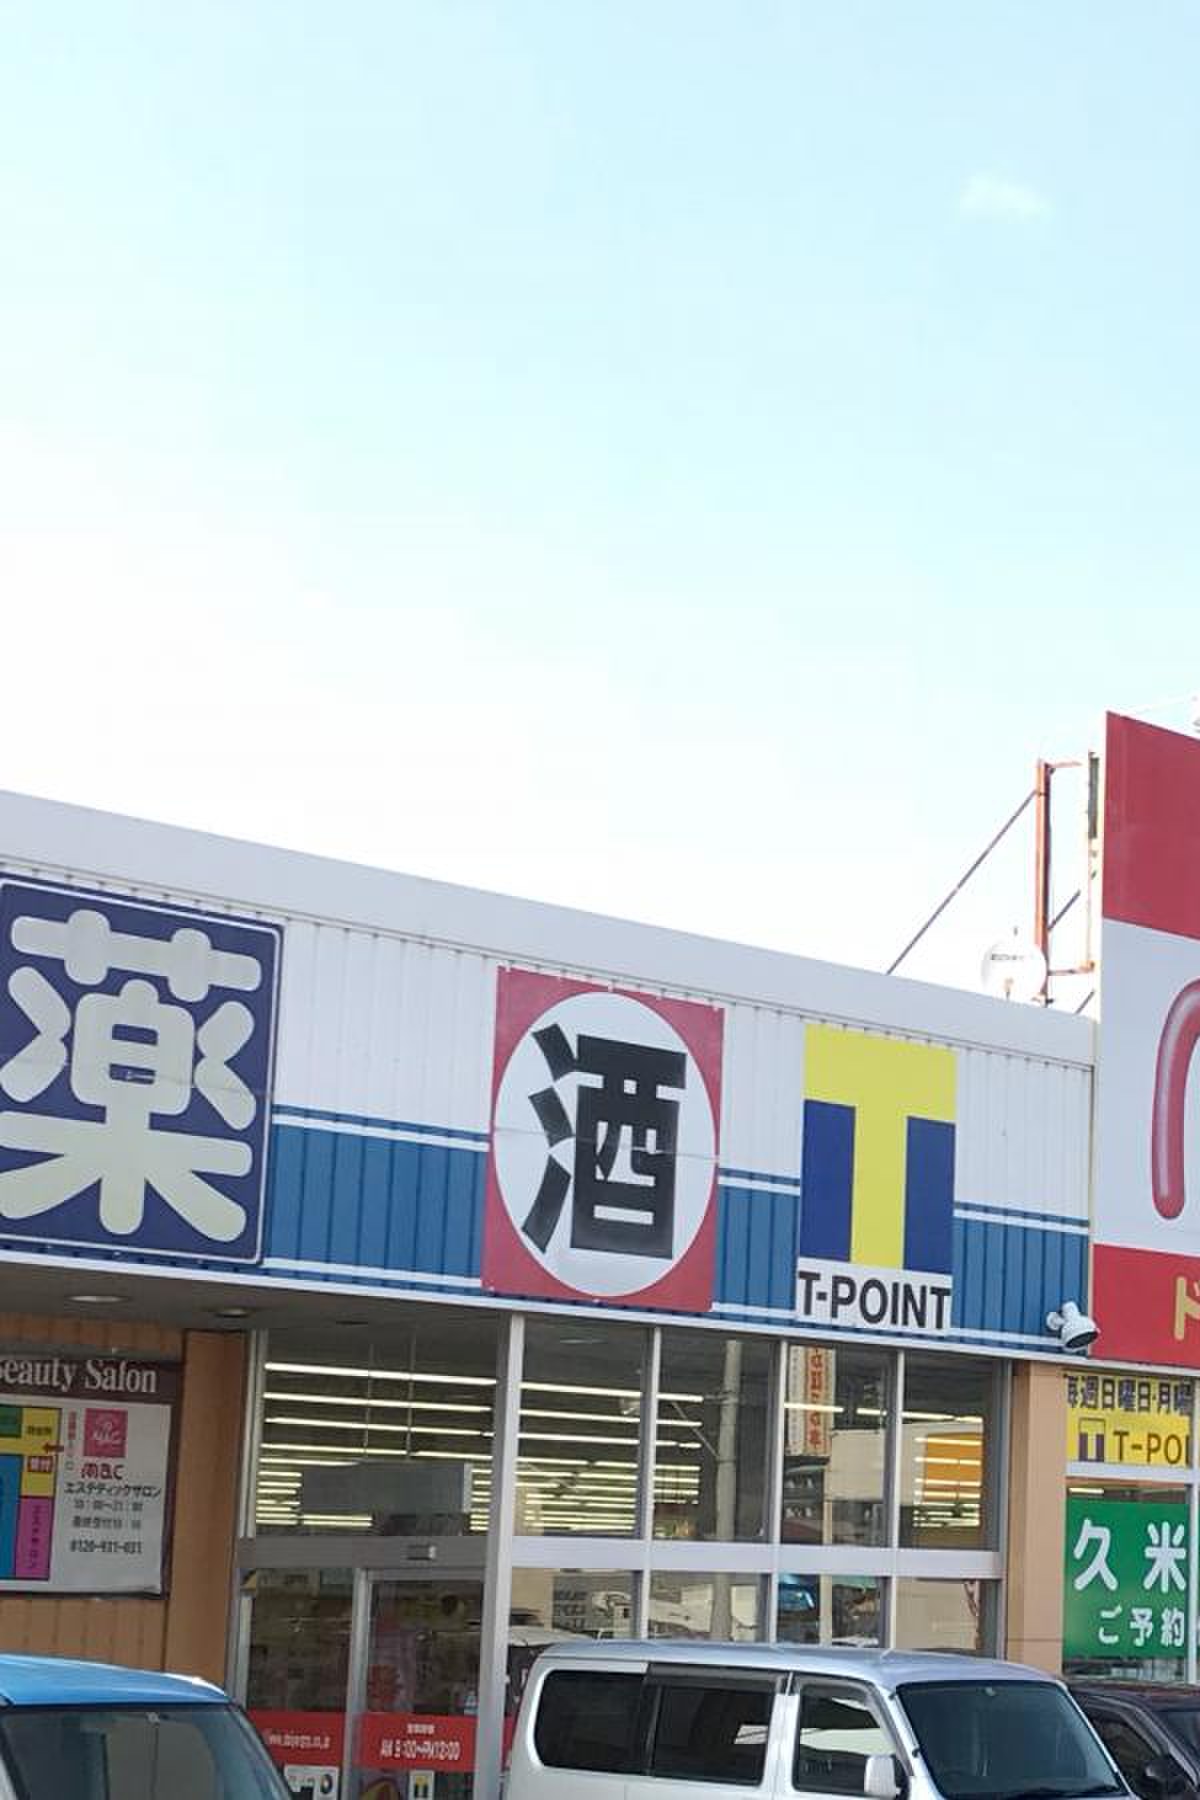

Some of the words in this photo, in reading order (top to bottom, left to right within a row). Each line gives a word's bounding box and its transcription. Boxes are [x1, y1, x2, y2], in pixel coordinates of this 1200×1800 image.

[0, 908, 261, 1242] 薬
[520, 1022, 688, 1259] 酒
[798, 1267, 952, 1330] T-POINT
[0, 1355, 77, 1391] eauty
[84, 1358, 156, 1393] Salon
